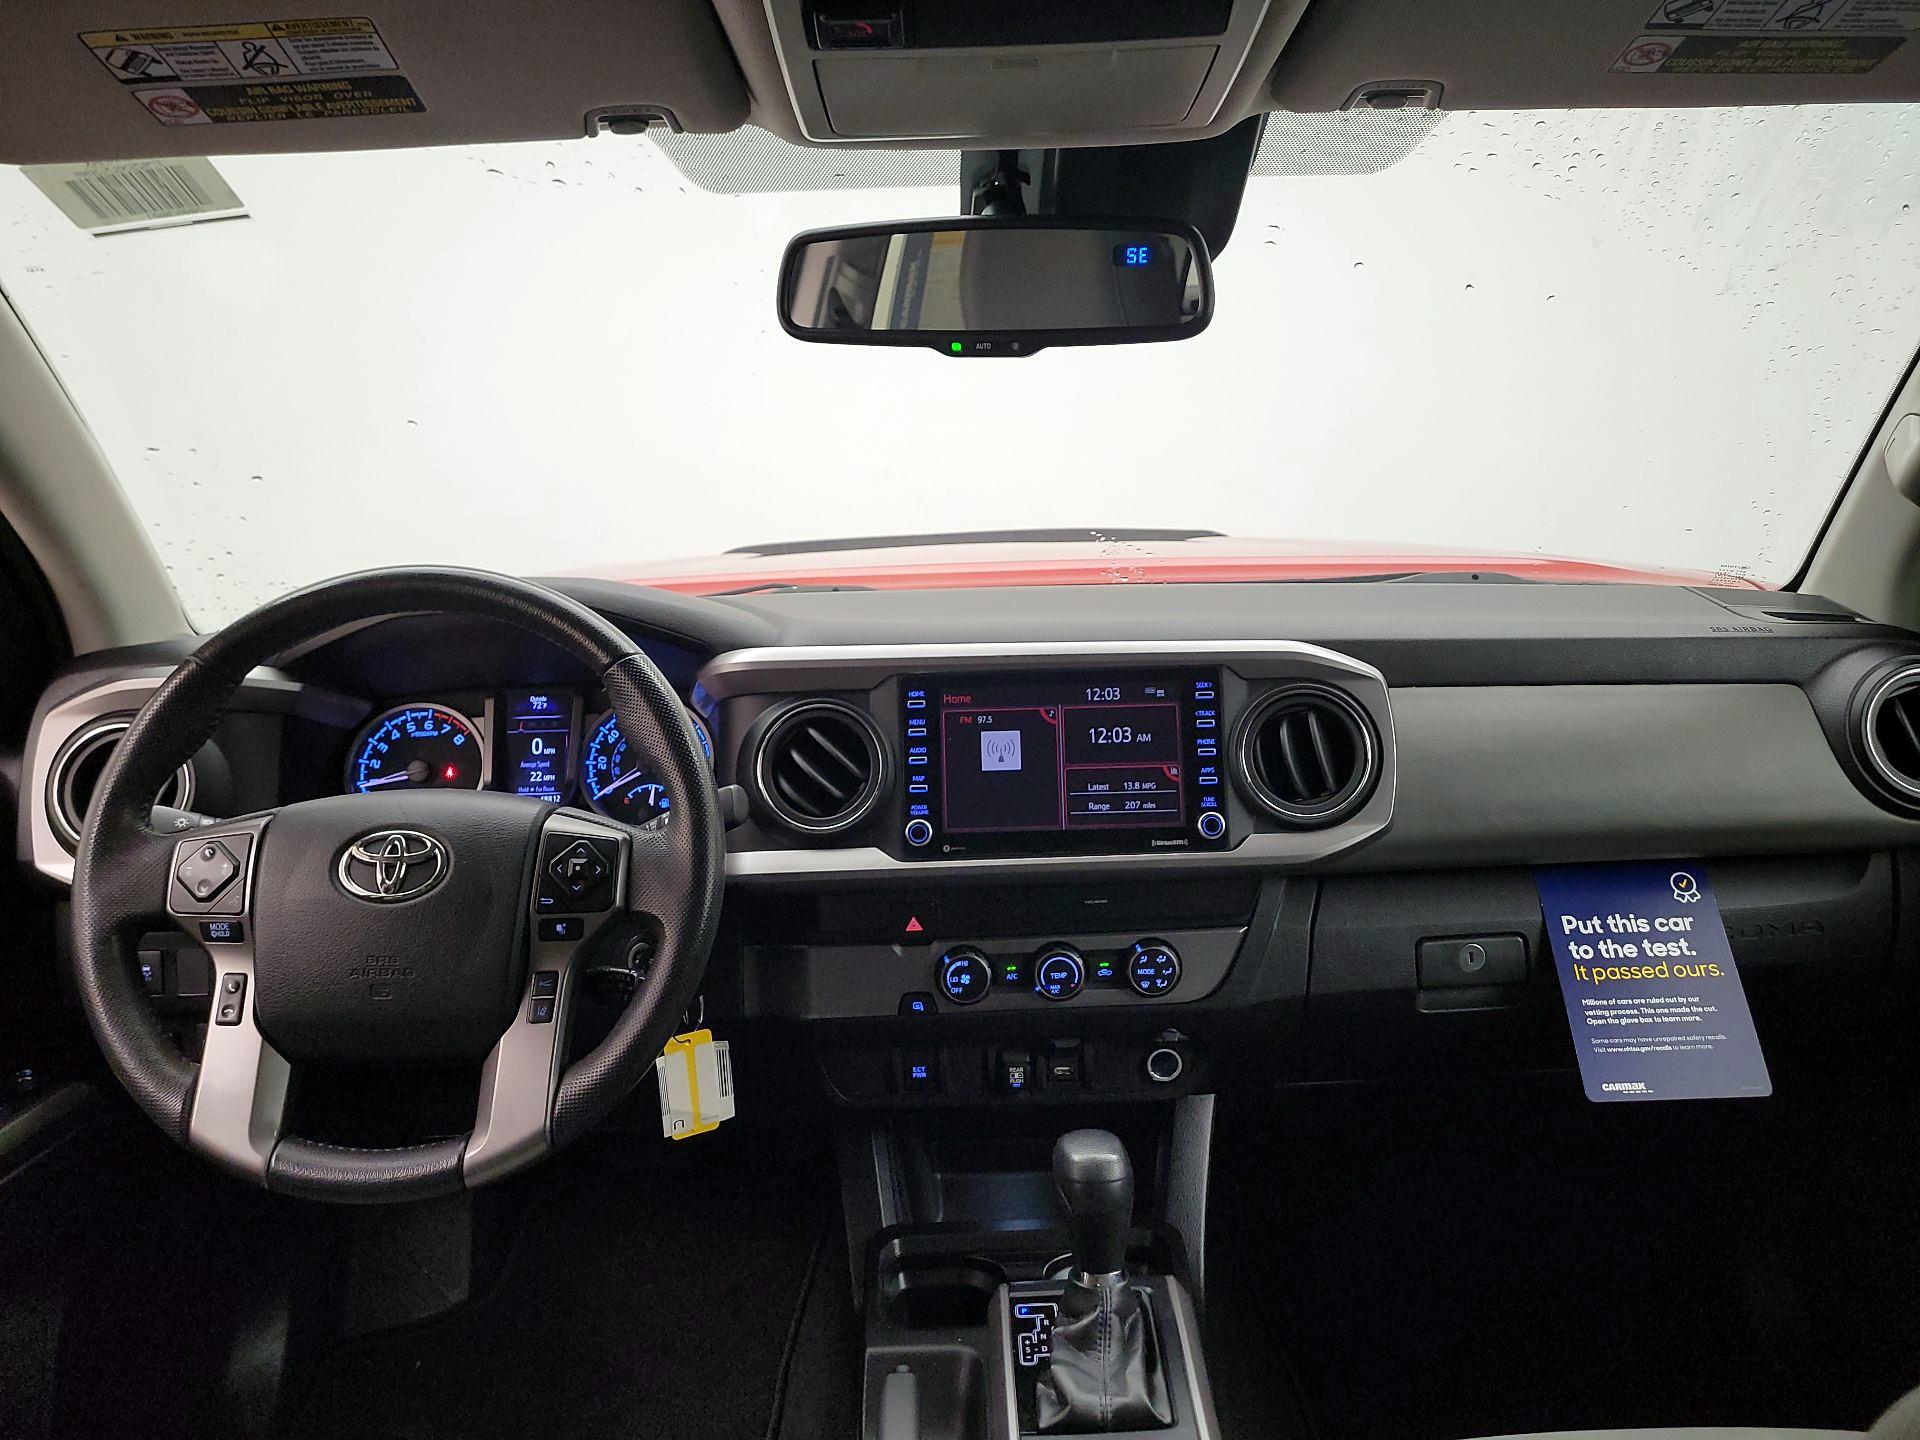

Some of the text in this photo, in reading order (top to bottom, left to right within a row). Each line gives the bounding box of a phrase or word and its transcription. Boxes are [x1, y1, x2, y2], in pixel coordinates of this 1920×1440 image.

[1126, 247, 1148, 264] SE
[976, 342, 992, 350] AUTO
[943, 694, 972, 703] Home
[1085, 687, 1121, 701] 12:03
[977, 715, 993, 723] 97.5
[406, 722, 416, 733] 5
[424, 720, 434, 730] 6
[440, 724, 452, 734] 7
[391, 729, 401, 740] 4
[453, 733, 466, 746] 8
[607, 729, 620, 744] 40
[1089, 727, 1152, 743] 12:03 AM
[377, 742, 389, 754] 3
[531, 737, 543, 755] 0
[369, 759, 381, 769] 2
[597, 756, 607, 770] 20
[530, 771, 542, 782] 22
[1088, 781, 1156, 791] Latest 13.8 MPG
[1088, 802, 1110, 811] Range
[1125, 801, 1140, 809] 207
[210, 922, 230, 930] MODE
[1561, 914, 1693, 934] Put this car
[1568, 938, 1697, 959] to the test.
[1006, 973, 1018, 981] A/C
[1050, 972, 1068, 980] TEMP
[1573, 961, 1725, 985] It passed ours.
[1582, 998, 1607, 1006] Millions
[1646, 996, 1665, 1004] ruled
[1677, 995, 1687, 1004] by
[1584, 1008, 1609, 1017] vetting
[1610, 1008, 1640, 1016] process.
[1586, 1017, 1607, 1026] Open
[1619, 1017, 1639, 1025] glove
